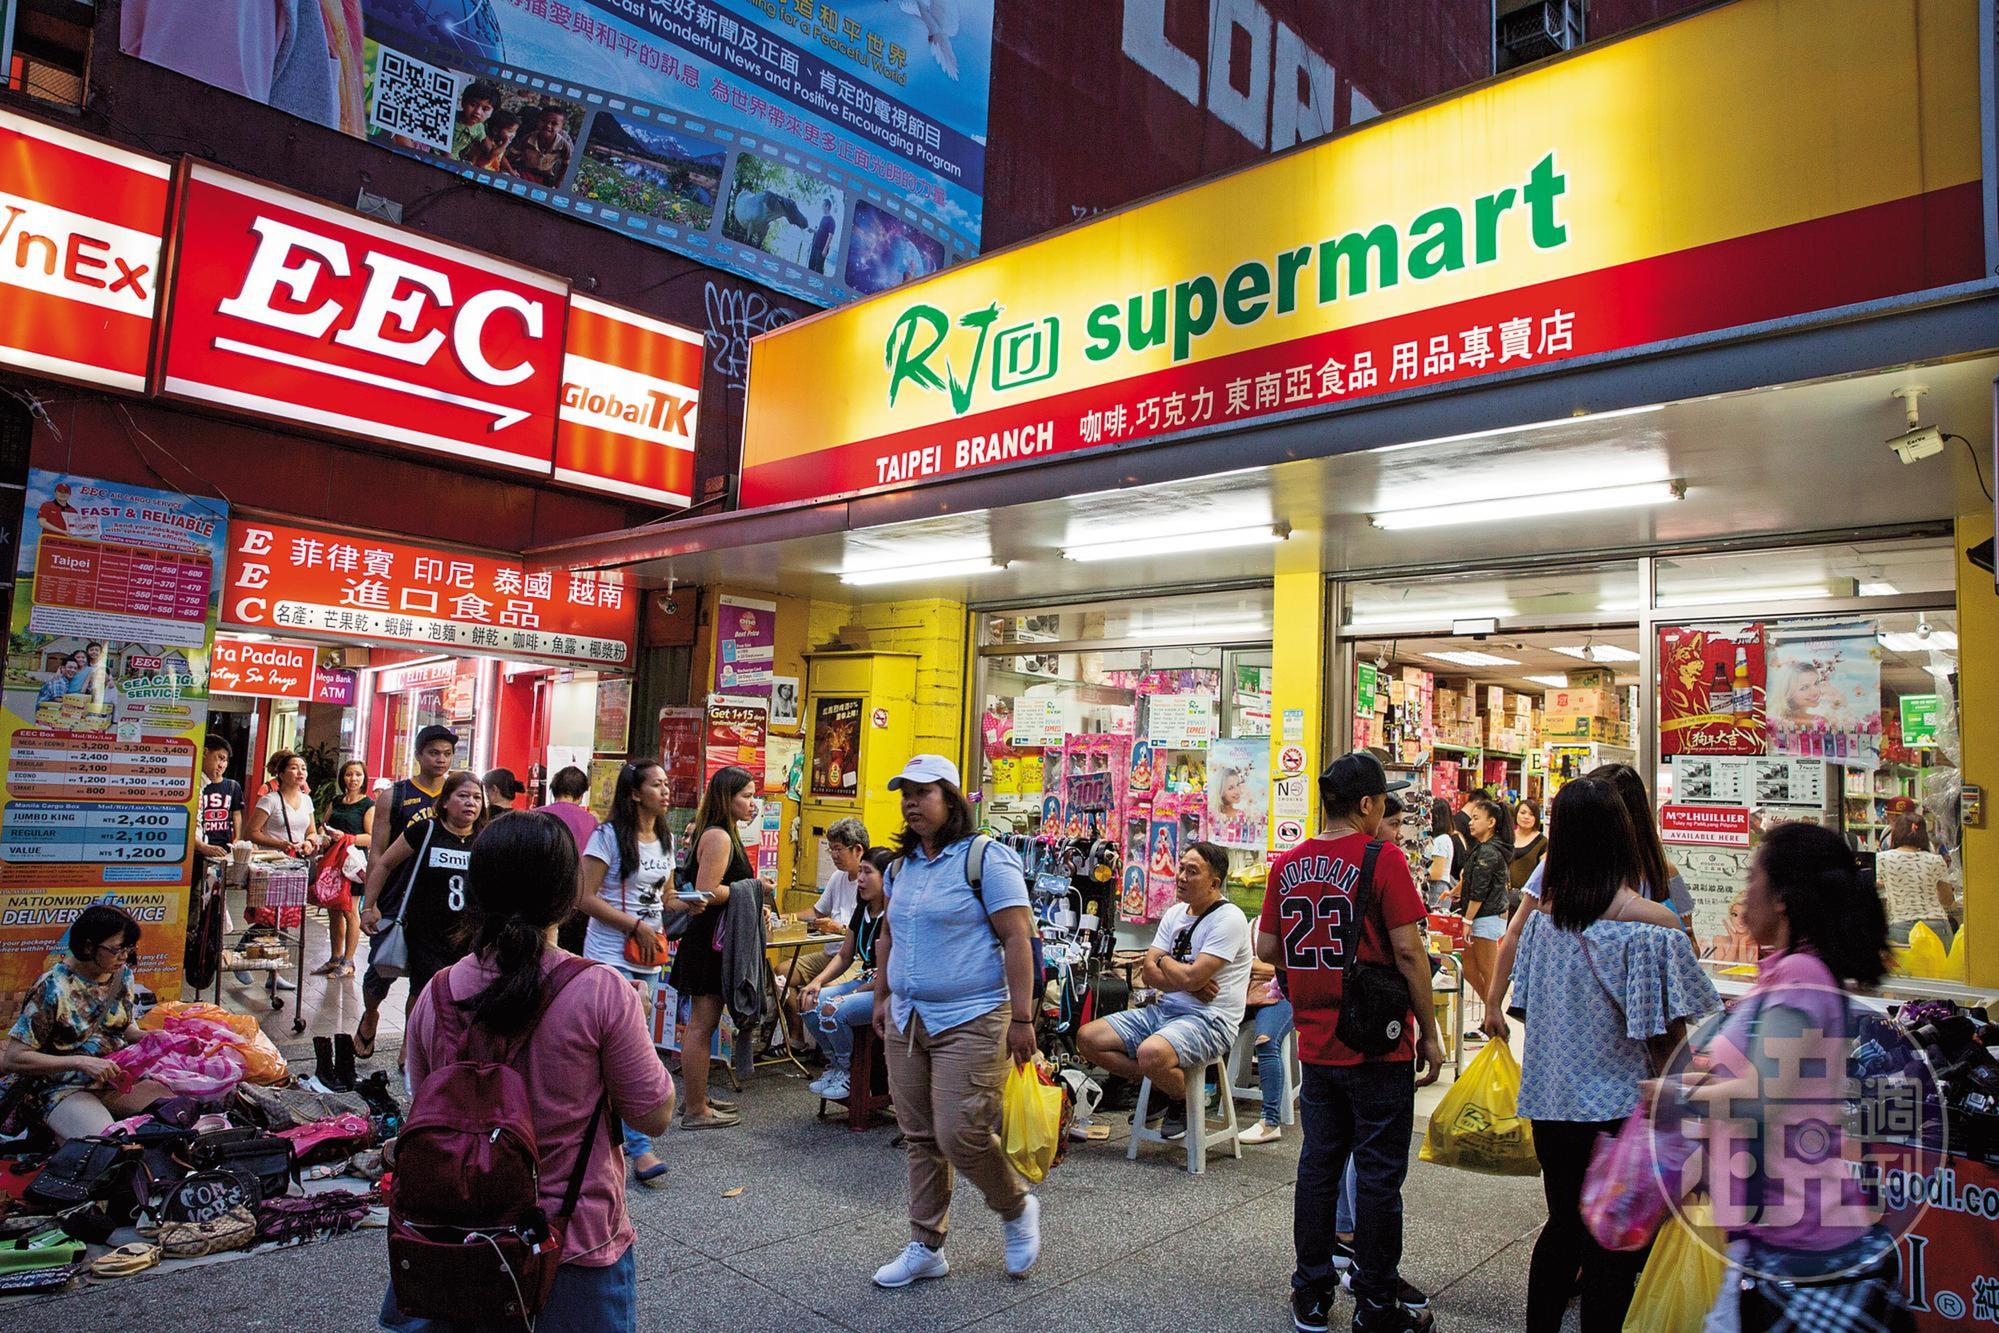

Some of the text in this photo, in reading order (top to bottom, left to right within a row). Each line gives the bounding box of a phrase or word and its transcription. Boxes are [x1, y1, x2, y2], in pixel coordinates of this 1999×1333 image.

[779, 6, 907, 86] for a Peaceful World
[649, 7, 961, 178] Wonderful News and Positive Encouraging Program
[1084, 152, 1567, 361] supermart
[214, 215, 544, 387] EEC
[1225, 350, 1377, 413] 東南亞食品
[1389, 310, 1576, 380] 用品專賣店
[876, 420, 1054, 484] TAIPEI BRANCH
[80, 486, 184, 510] EEC AIR CARGO SERVICE
[81, 507, 214, 537] FAST & RELIABLE
[153, 526, 187, 537] packages
[52, 554, 90, 569] Taipei
[289, 538, 624, 610] 菲律賓 印尼 泰國 越南
[340, 578, 540, 628] 進口食品
[134, 658, 160, 668] EEC
[241, 645, 303, 668] Padala
[123, 677, 149, 689] SEA
[315, 672, 352, 685] Mega Bank
[127, 688, 180, 699] SERVICE
[320, 685, 346, 700] ATM
[710, 708, 731, 719] Get
[732, 709, 754, 720] 1+15
[1692, 729, 1740, 747] 狗年大吉
[117, 815, 169, 826] 2,400
[11, 829, 56, 837] REGULAR
[115, 831, 168, 843] 2,100
[1670, 832, 1740, 842] AVAILABLE HERE
[9, 846, 42, 854] VALUE
[115, 848, 166, 859] 1,200
[439, 852, 469, 867] Smi
[1279, 855, 1360, 895] JORDAN
[8, 894, 165, 907] NATIONWIDE (TAIWAN)
[448, 875, 465, 912] 8
[126, 906, 166, 922] VICE
[1279, 895, 1353, 970] 23
